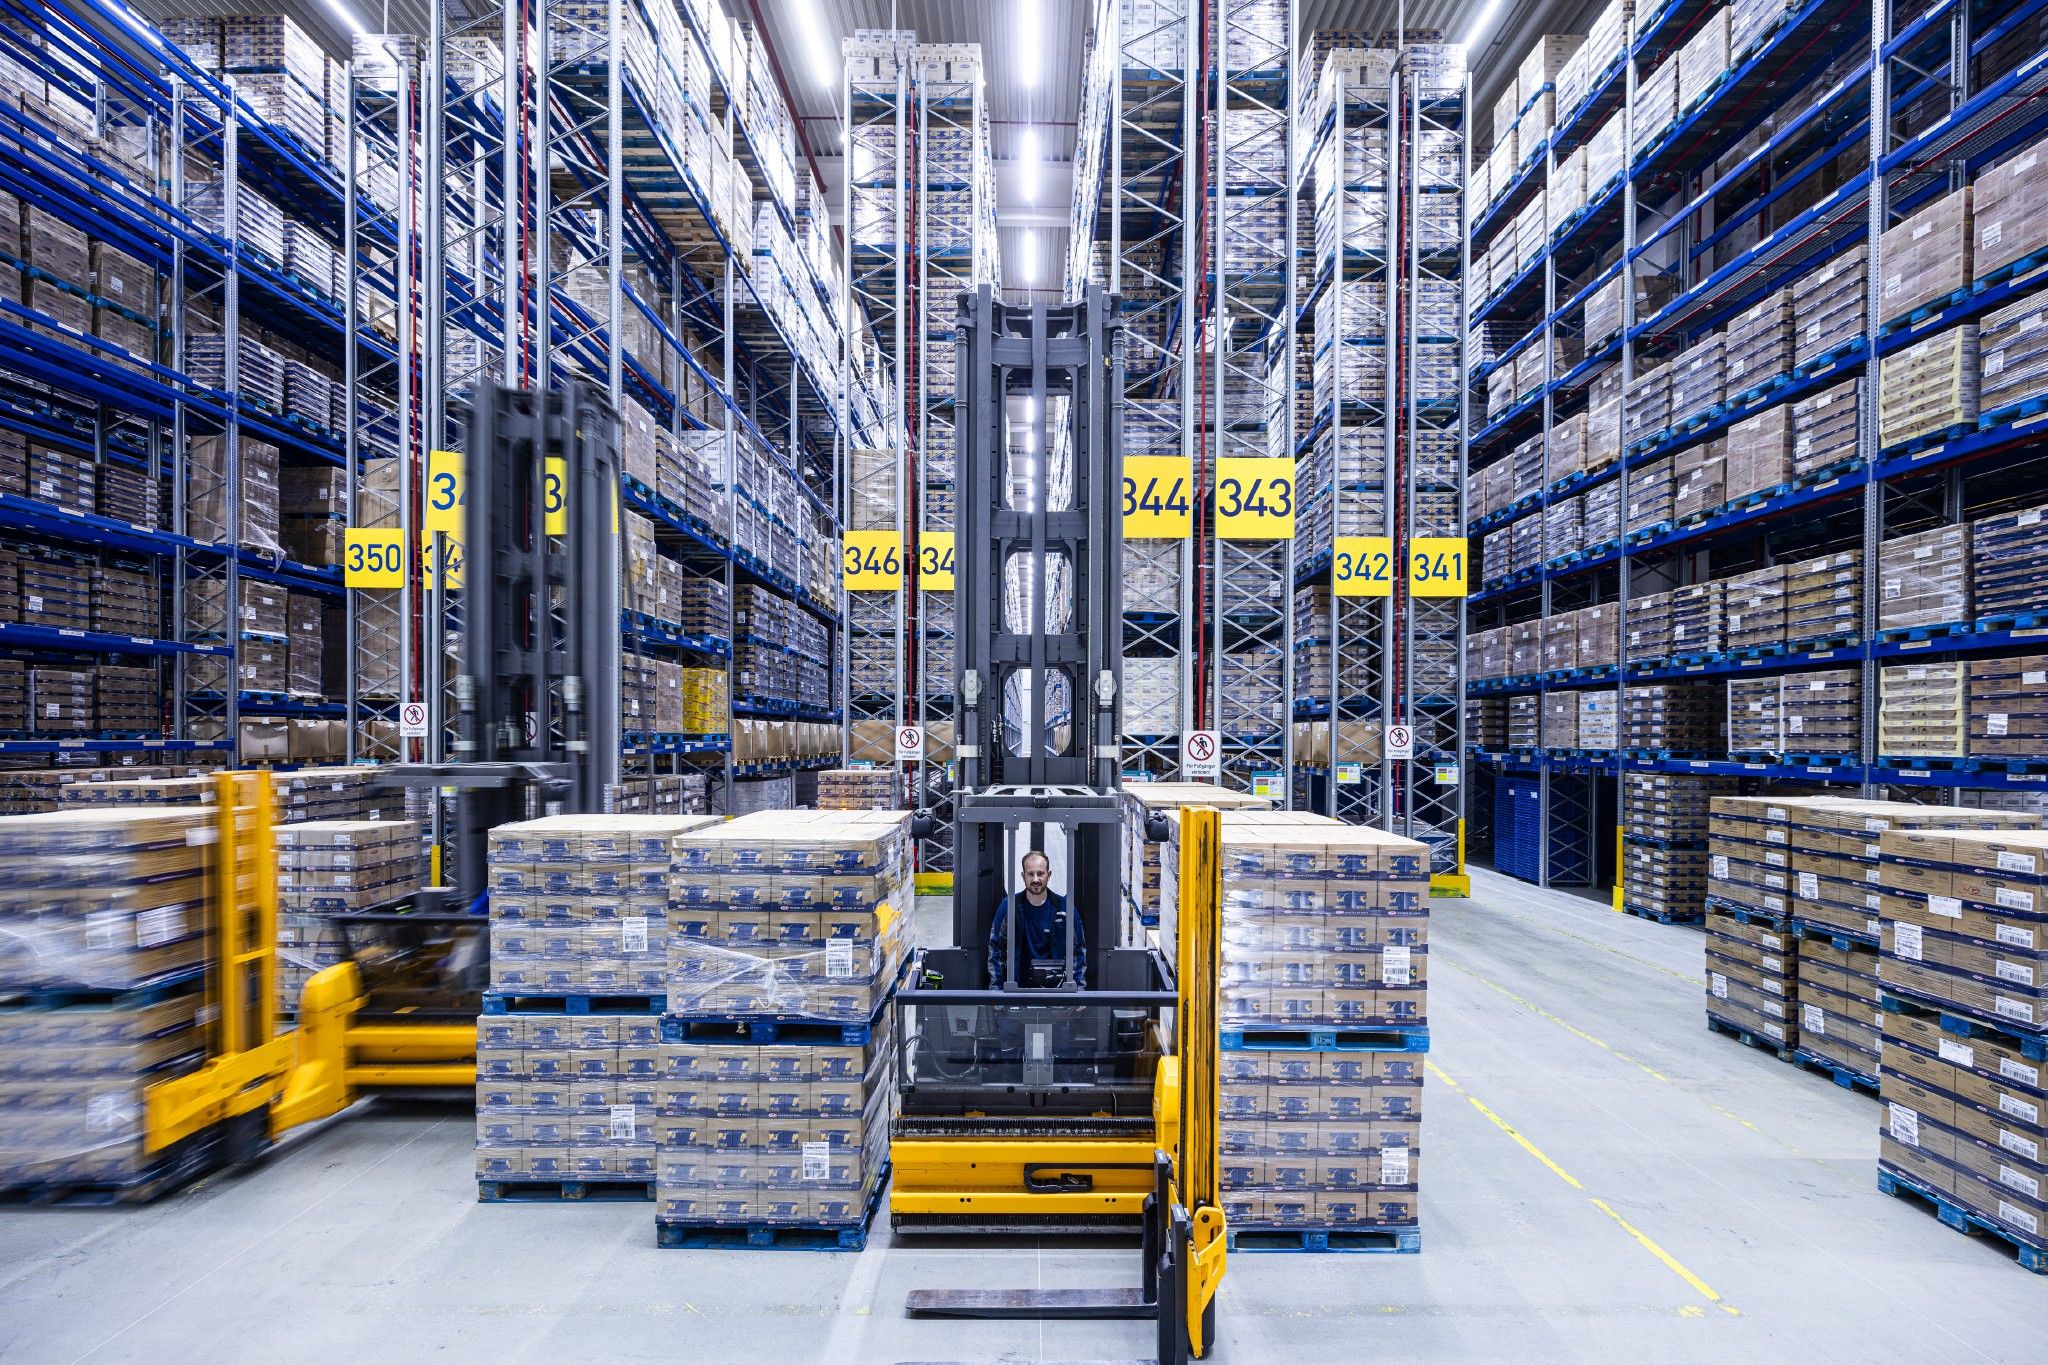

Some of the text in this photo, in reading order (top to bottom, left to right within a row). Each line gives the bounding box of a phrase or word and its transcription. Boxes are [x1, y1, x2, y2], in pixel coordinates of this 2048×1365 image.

[1123, 477, 1189, 516] 344
[1219, 478, 1292, 517] 343
[347, 543, 401, 573] 350
[844, 546, 900, 575] 346
[921, 546, 955, 575] 34
[1336, 552, 1389, 581] 342
[1413, 553, 1462, 581] 341
